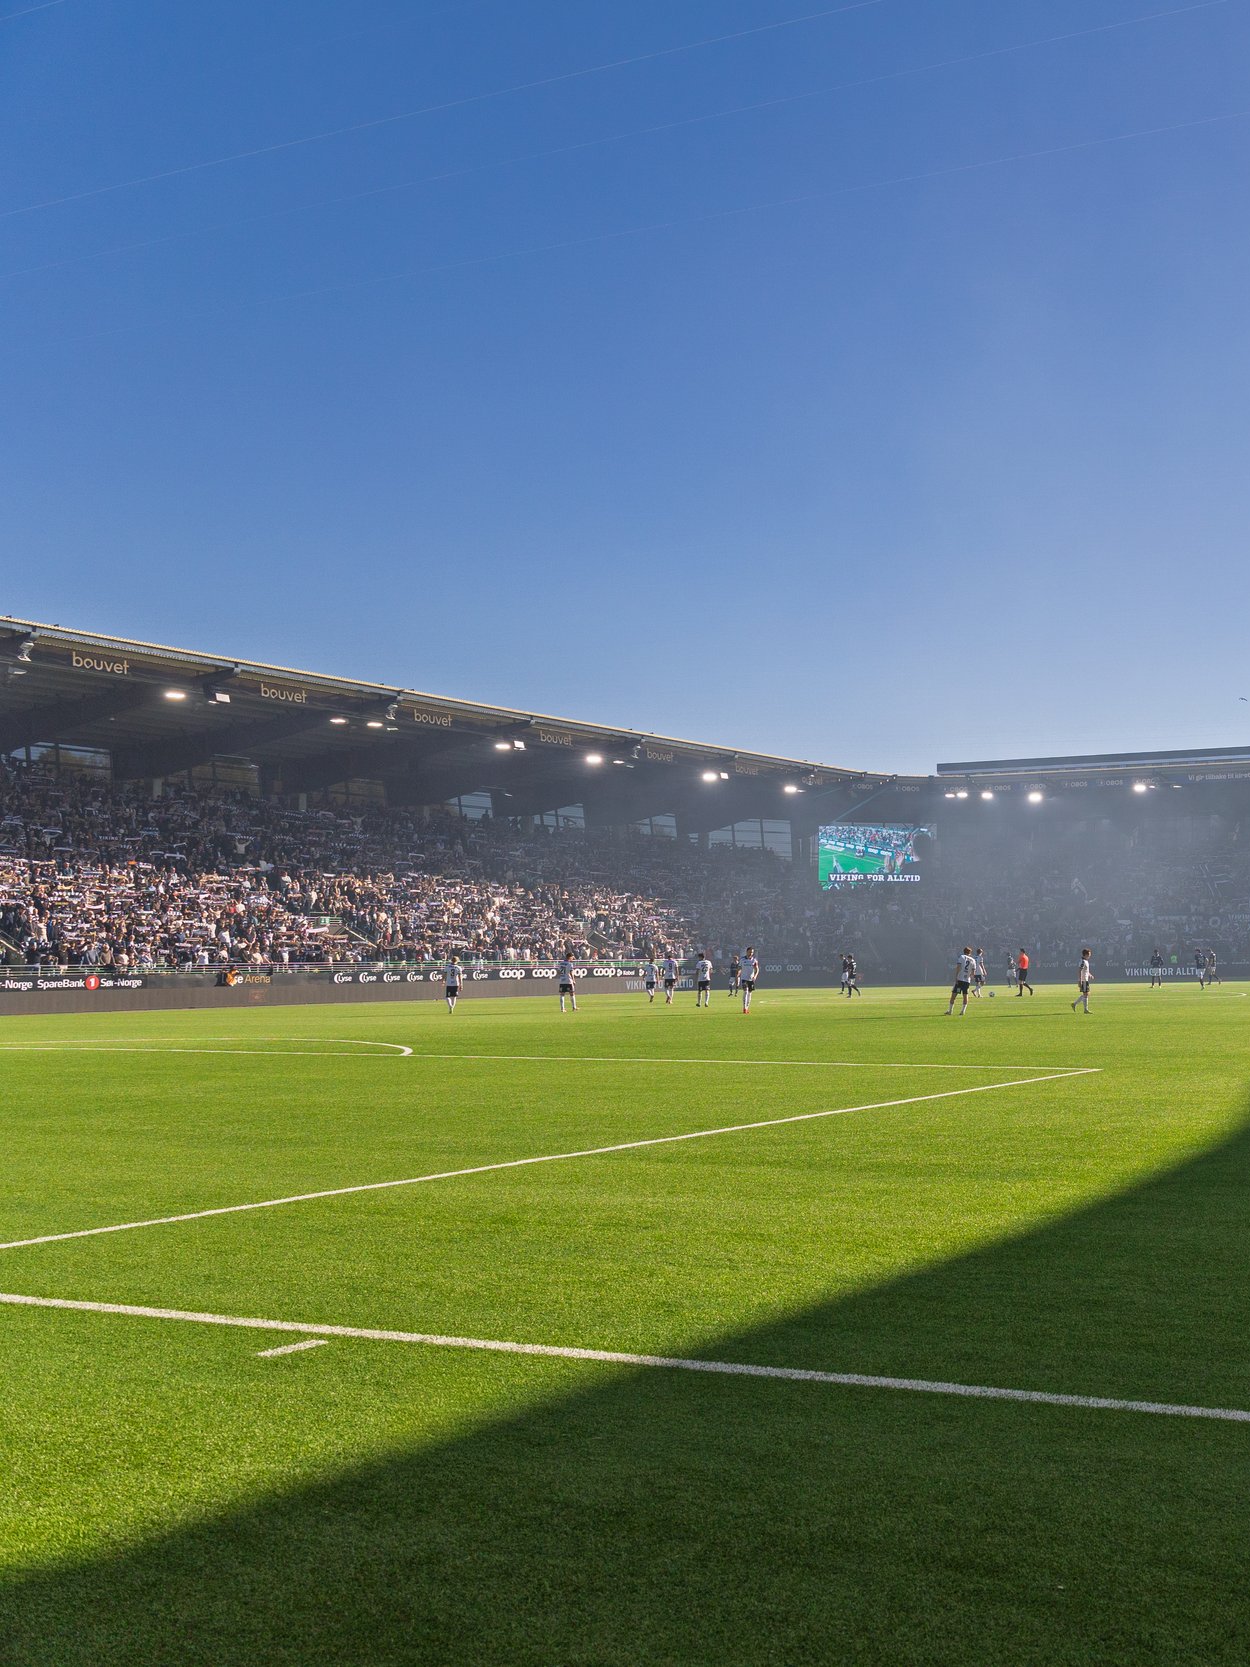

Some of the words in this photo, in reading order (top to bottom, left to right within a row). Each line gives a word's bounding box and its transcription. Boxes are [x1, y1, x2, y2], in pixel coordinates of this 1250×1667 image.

[72, 652, 129, 674] bouvet
[261, 684, 307, 703] bouvet
[414, 709, 452, 727] bouvet
[540, 731, 572, 745] bouvet
[829, 874, 864, 882] VIKING
[866, 874, 884, 882] FOR
[886, 874, 921, 882] ALLTID
[593, 967, 616, 978] coop
[765, 964, 782, 973] coop
[786, 964, 802, 973] coop
[244, 974, 271, 984] Arena
[338, 973, 352, 983] Lyse
[362, 973, 377, 982] Lyse
[387, 973, 401, 981] Lyse
[410, 972, 424, 981] Lyse
[499, 969, 525, 979] coop
[532, 969, 557, 979] coop
[37, 978, 85, 991] SpareBank
[625, 980, 646, 990] VIKIN
